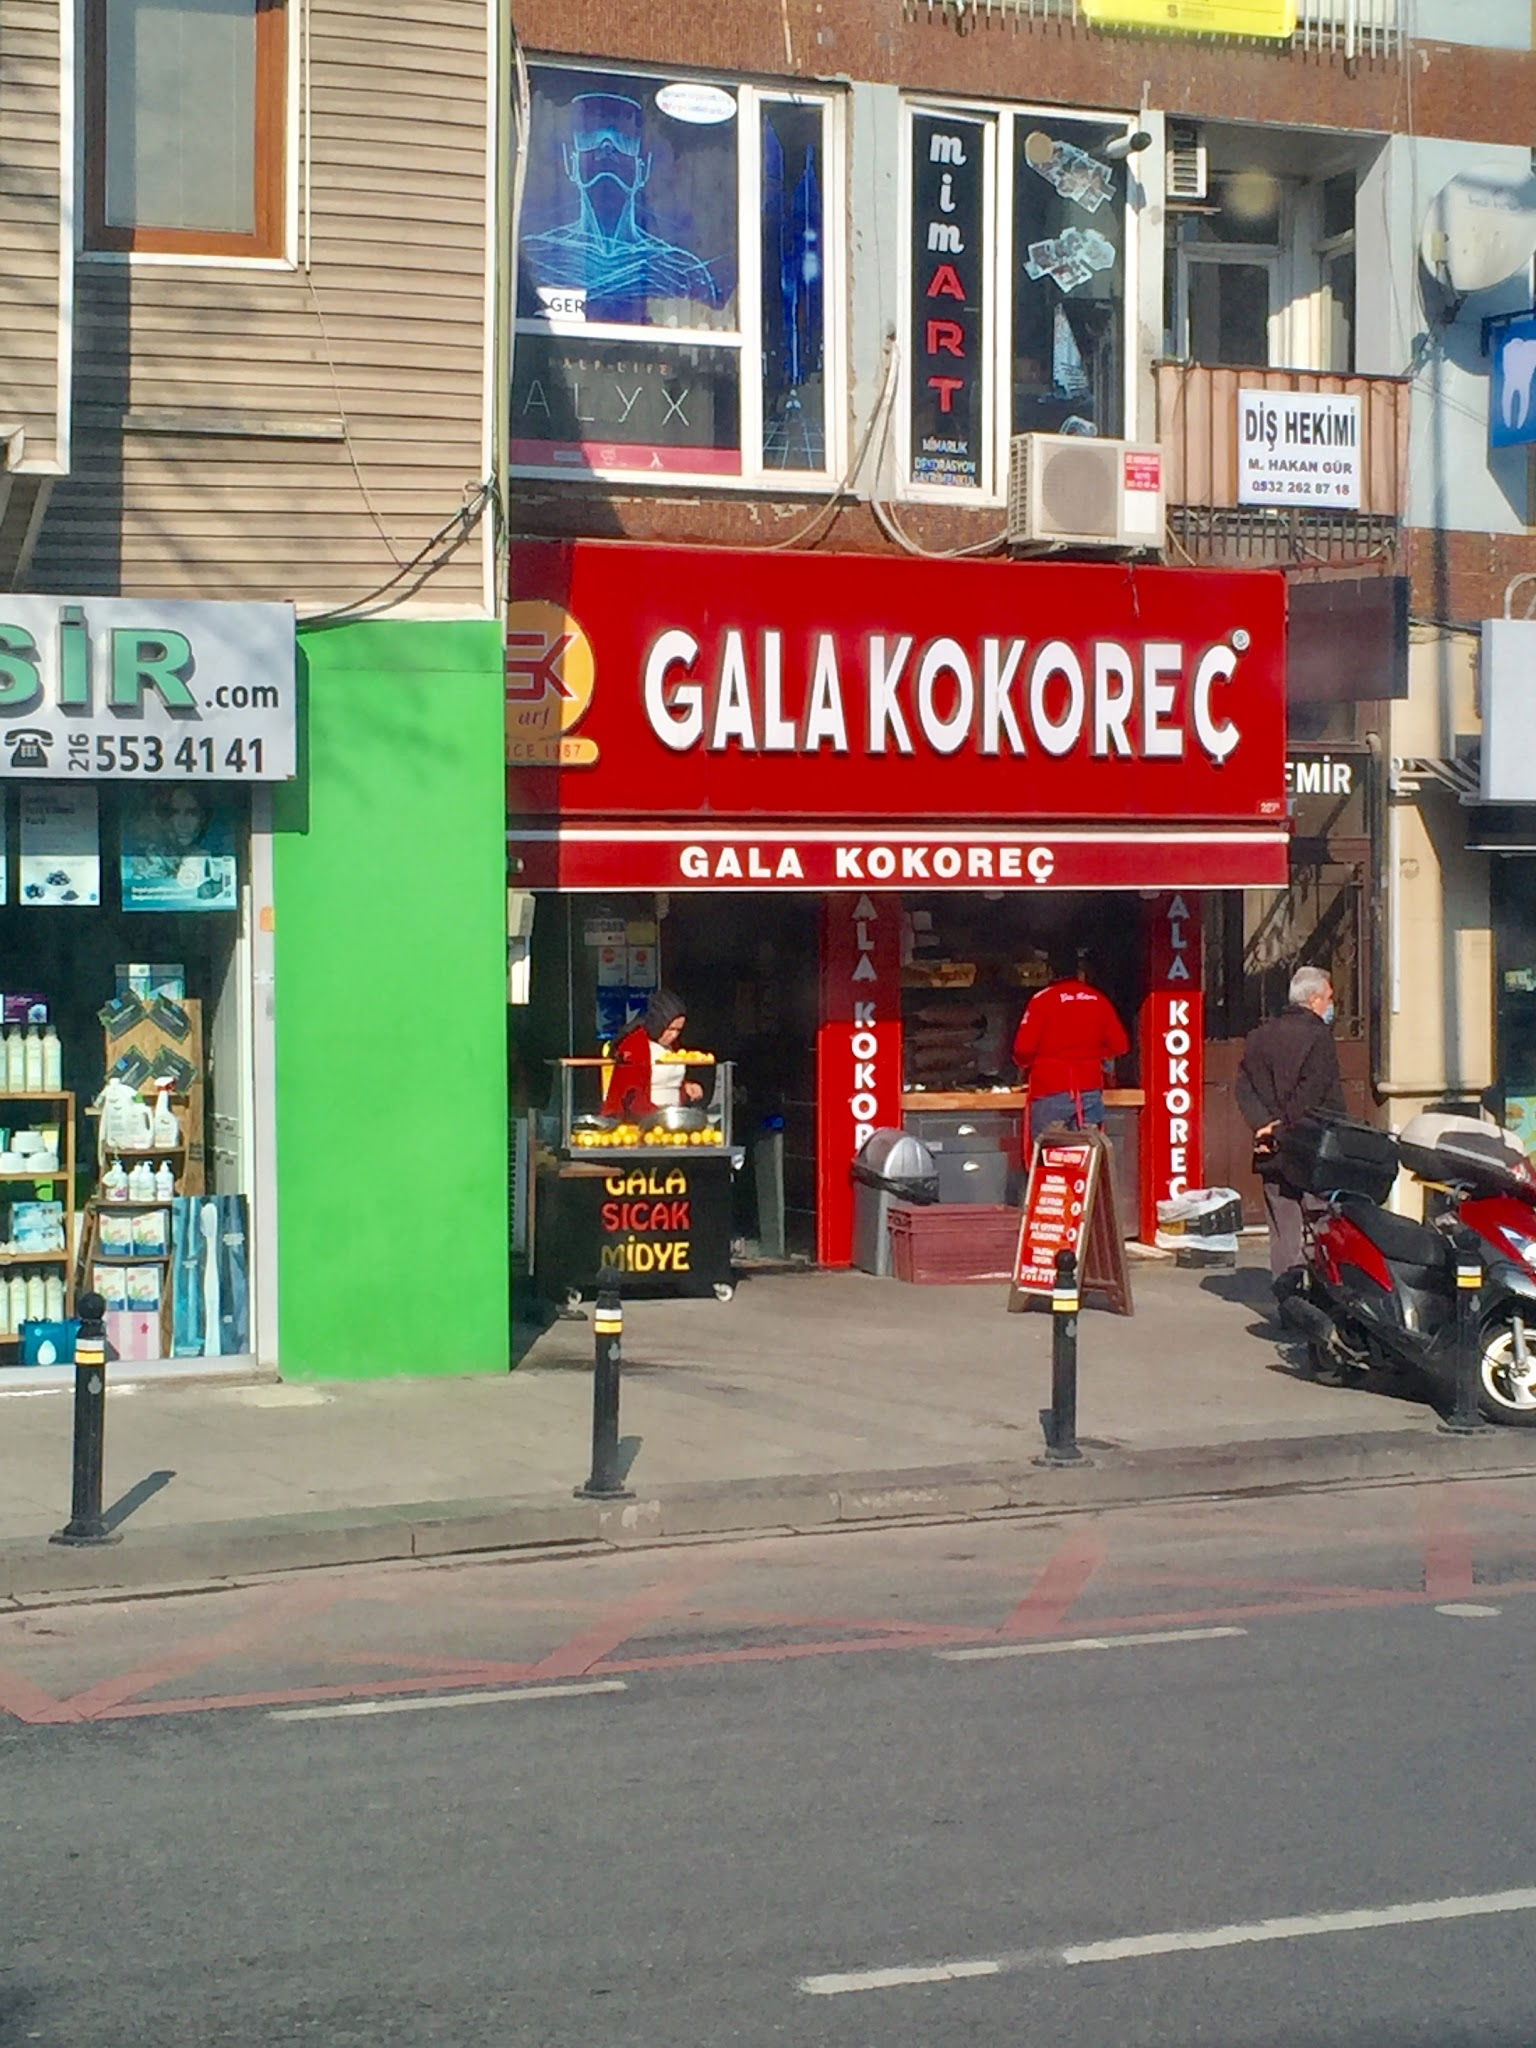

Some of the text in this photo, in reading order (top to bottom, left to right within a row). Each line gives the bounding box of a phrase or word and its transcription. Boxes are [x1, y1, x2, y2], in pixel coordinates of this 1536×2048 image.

[1245, 401, 1356, 452] DİŞ HEKİMİ
[1248, 458, 1264, 471] M.
[1268, 459, 1318, 473] HAKAN
[645, 629, 1241, 765] GALA KOKOREÇ
[69, 733, 89, 772] 216
[96, 735, 163, 772] 553
[680, 846, 1055, 883] GALA KOKOREÇ
[851, 892, 878, 982] ALA
[1167, 894, 1191, 981] ALA
[606, 1167, 687, 1195] GALA
[601, 1201, 690, 1232] SICAK
[601, 1235, 690, 1272] MİDYE
